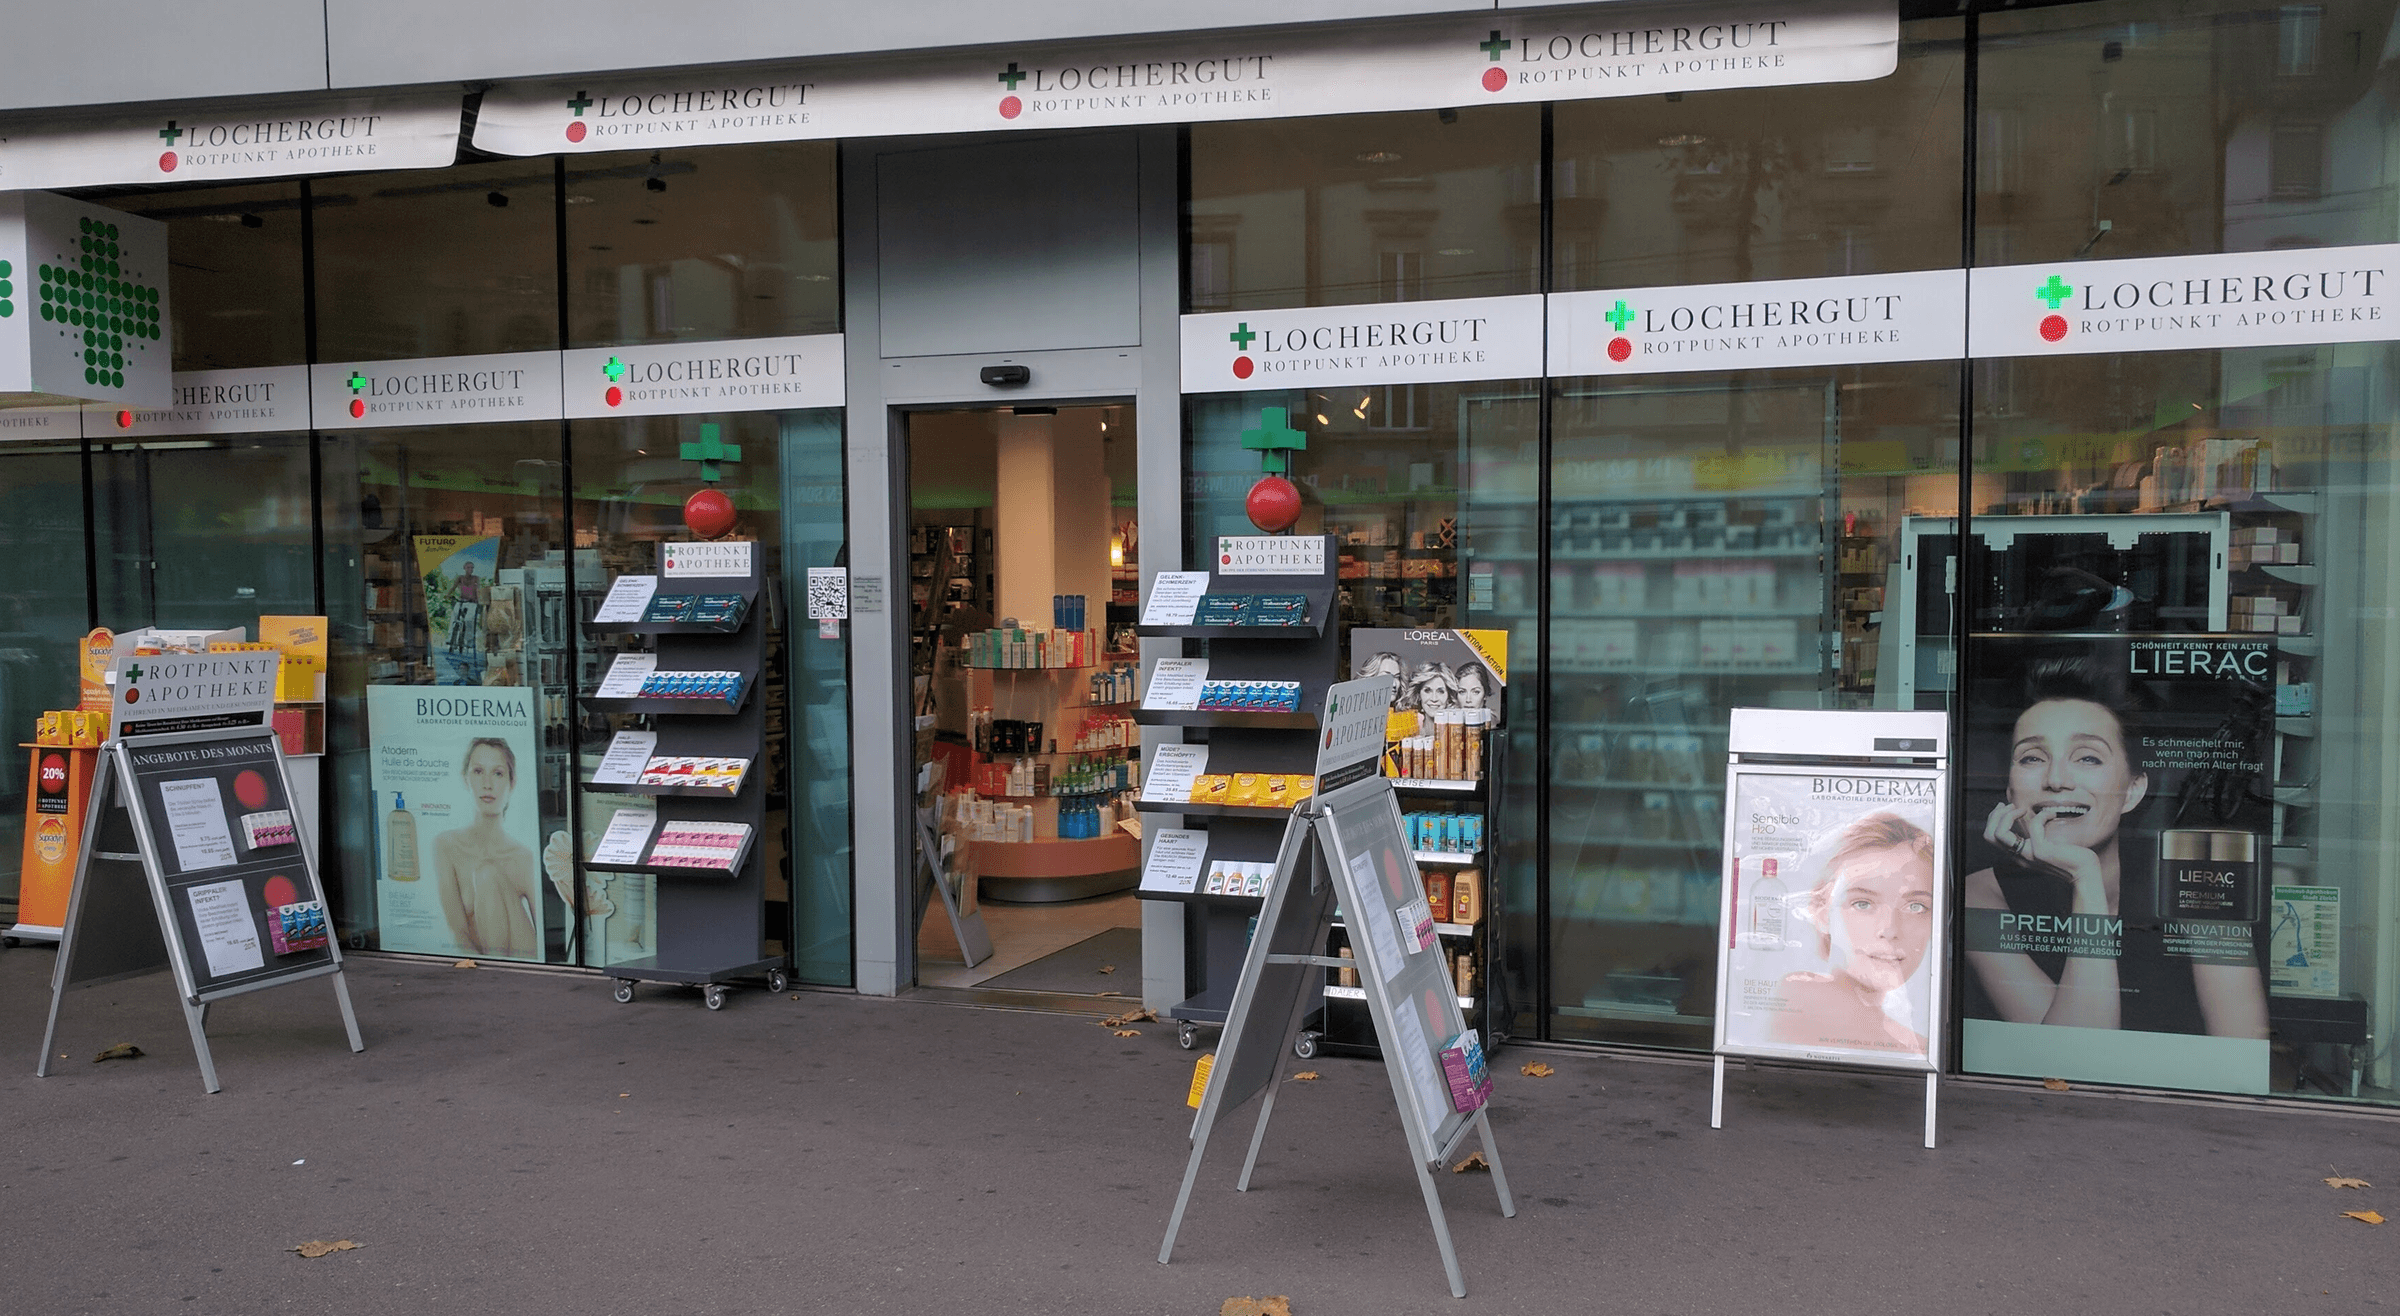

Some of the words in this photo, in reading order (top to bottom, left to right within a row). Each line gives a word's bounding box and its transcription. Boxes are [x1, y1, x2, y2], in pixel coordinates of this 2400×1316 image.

[1520, 20, 1788, 63] LOCHERGUT
[1033, 55, 1274, 92] LOCHERGUT
[1518, 64, 1646, 85] ROTPUNKT
[1657, 54, 1787, 75] APOTHEKE
[598, 83, 815, 118] LOCHERGUT
[1032, 94, 1148, 113] ROTPUNKT
[1157, 87, 1273, 106] APOTHEKE
[188, 115, 381, 148] LOCHERGUT
[595, 119, 700, 136] ROTPUNKT
[707, 112, 812, 130] APOTHEKE
[185, 151, 277, 167] ROTPUNKT
[286, 143, 378, 161] APOTHEKE
[2082, 268, 2385, 311] LOCHERGUT
[1643, 295, 1901, 334] LOCHERGUT
[2081, 313, 2222, 334] ROTPUNKT
[2236, 306, 2382, 327] APOTHEKE
[1263, 317, 1488, 354] LOCHERGUT
[1643, 336, 1765, 356] ROTPUNKT
[1776, 329, 1901, 349] APOTHEKE
[629, 353, 803, 384] LOCHERGUT
[1263, 356, 1368, 374] ROTPUNKT
[1378, 349, 1487, 368] APOTHEKE
[370, 368, 525, 397] LOCHERGUT
[629, 386, 711, 402] ROTPUNKT
[718, 381, 803, 397] APOTHEKE
[370, 400, 446, 414] ROTPUNKT
[449, 395, 525, 412] APOTHEKE
[0, 417, 49, 428] OTHEKE
[136, 410, 202, 423] ROTPUNKT
[208, 408, 275, 420] APOTHEKE
[419, 538, 456, 546] FUTURO
[1236, 539, 1323, 551] ROTPUNKT
[678, 545, 750, 556] ROTPUNKT
[678, 559, 750, 569] APOTHEKE
[1235, 554, 1323, 565] APOTHEKE
[1404, 631, 1454, 641] L'ORÉAL
[1463, 631, 1484, 652] AKTION
[1484, 654, 1505, 676] ACTION
[2183, 642, 2213, 650] KENNT
[149, 659, 271, 680] ROTPUNKT
[2130, 650, 2268, 675] LIERAC
[146, 680, 268, 702] APOTHEKE
[416, 698, 527, 718] BIODERMA
[1338, 686, 1390, 716] ROTPUNKT
[464, 719, 528, 727] DERMATOLOGIQUE
[1332, 714, 1386, 747] APOTHEKE
[381, 745, 418, 755] Atoderm
[2142, 737, 2155, 747] Es
[2158, 738, 2221, 748] schmeichelt
[132, 749, 199, 766] ANGEBOTE
[201, 747, 224, 759] DES
[226, 742, 273, 757] MONATS
[2212, 750, 2239, 759] mich
[381, 758, 400, 766] Huile
[403, 759, 415, 767] de
[416, 758, 449, 768] douche
[2142, 759, 2166, 768] nach
[2169, 760, 2210, 769] meinem
[2212, 760, 2237, 770] Alter
[2239, 761, 2264, 772] fragt
[42, 767, 64, 780] 20%
[165, 783, 205, 792] SCHNUPFEN?
[1812, 777, 1937, 797] BIODERMA
[1811, 794, 1863, 802] LABORATOIRE
[1752, 813, 1800, 825] Sensibio
[1752, 824, 1776, 835] H2O
[2179, 870, 2234, 885] LIERAC
[193, 886, 227, 898] GRIPPALER
[194, 894, 220, 904] INFEKT?
[2179, 890, 2225, 900] PREMIUM
[2000, 913, 2123, 937] PREMIUM
[2163, 923, 2252, 938] INNOVATION
[2000, 934, 2122, 948] AUSSERGEWÖHNLICHE
[2218, 940, 2253, 948] FORSCHUNG
[2000, 942, 2050, 953] HAUTPFLEGE
[2051, 945, 2089, 955] ANTI-AGE
[2090, 947, 2122, 957] ABSOLU
[2179, 946, 2225, 955] REGENERATIVEN
[1743, 987, 1771, 995] SELBST
[1744, 979, 1757, 987] DIE
[1757, 980, 1778, 988] HAUT
[1330, 987, 1360, 997] DAUER
